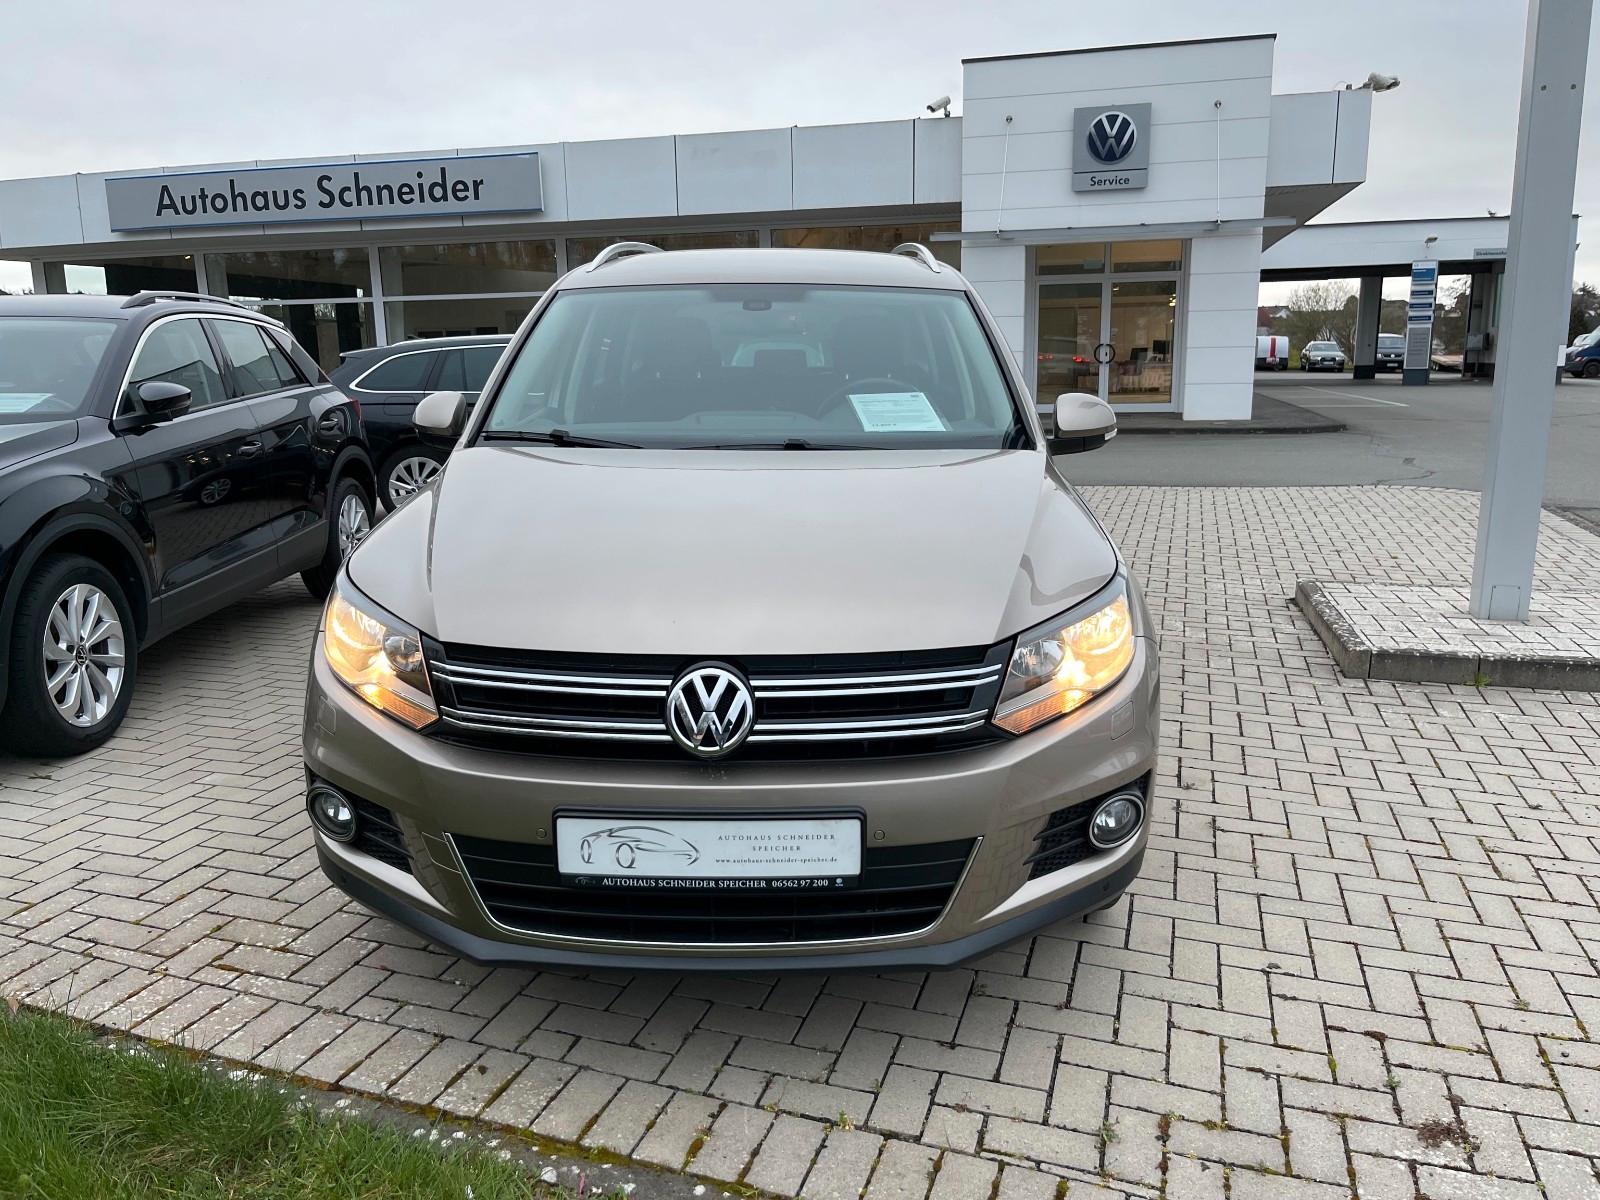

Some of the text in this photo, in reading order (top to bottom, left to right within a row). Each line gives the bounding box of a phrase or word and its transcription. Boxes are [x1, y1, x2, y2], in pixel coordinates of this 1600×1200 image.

[1090, 176, 1130, 187] Service
[156, 167, 485, 216] Autohaus Schneider
[715, 856, 838, 864] www.autohaus-schneider-speicher.de
[602, 877, 655, 887] AUTOHAUS
[658, 878, 716, 888] SCHNEIDER
[718, 880, 767, 888] SPEICHER
[772, 880, 798, 888] 06562
[800, 880, 810, 888] 97
[813, 879, 829, 887] 200
